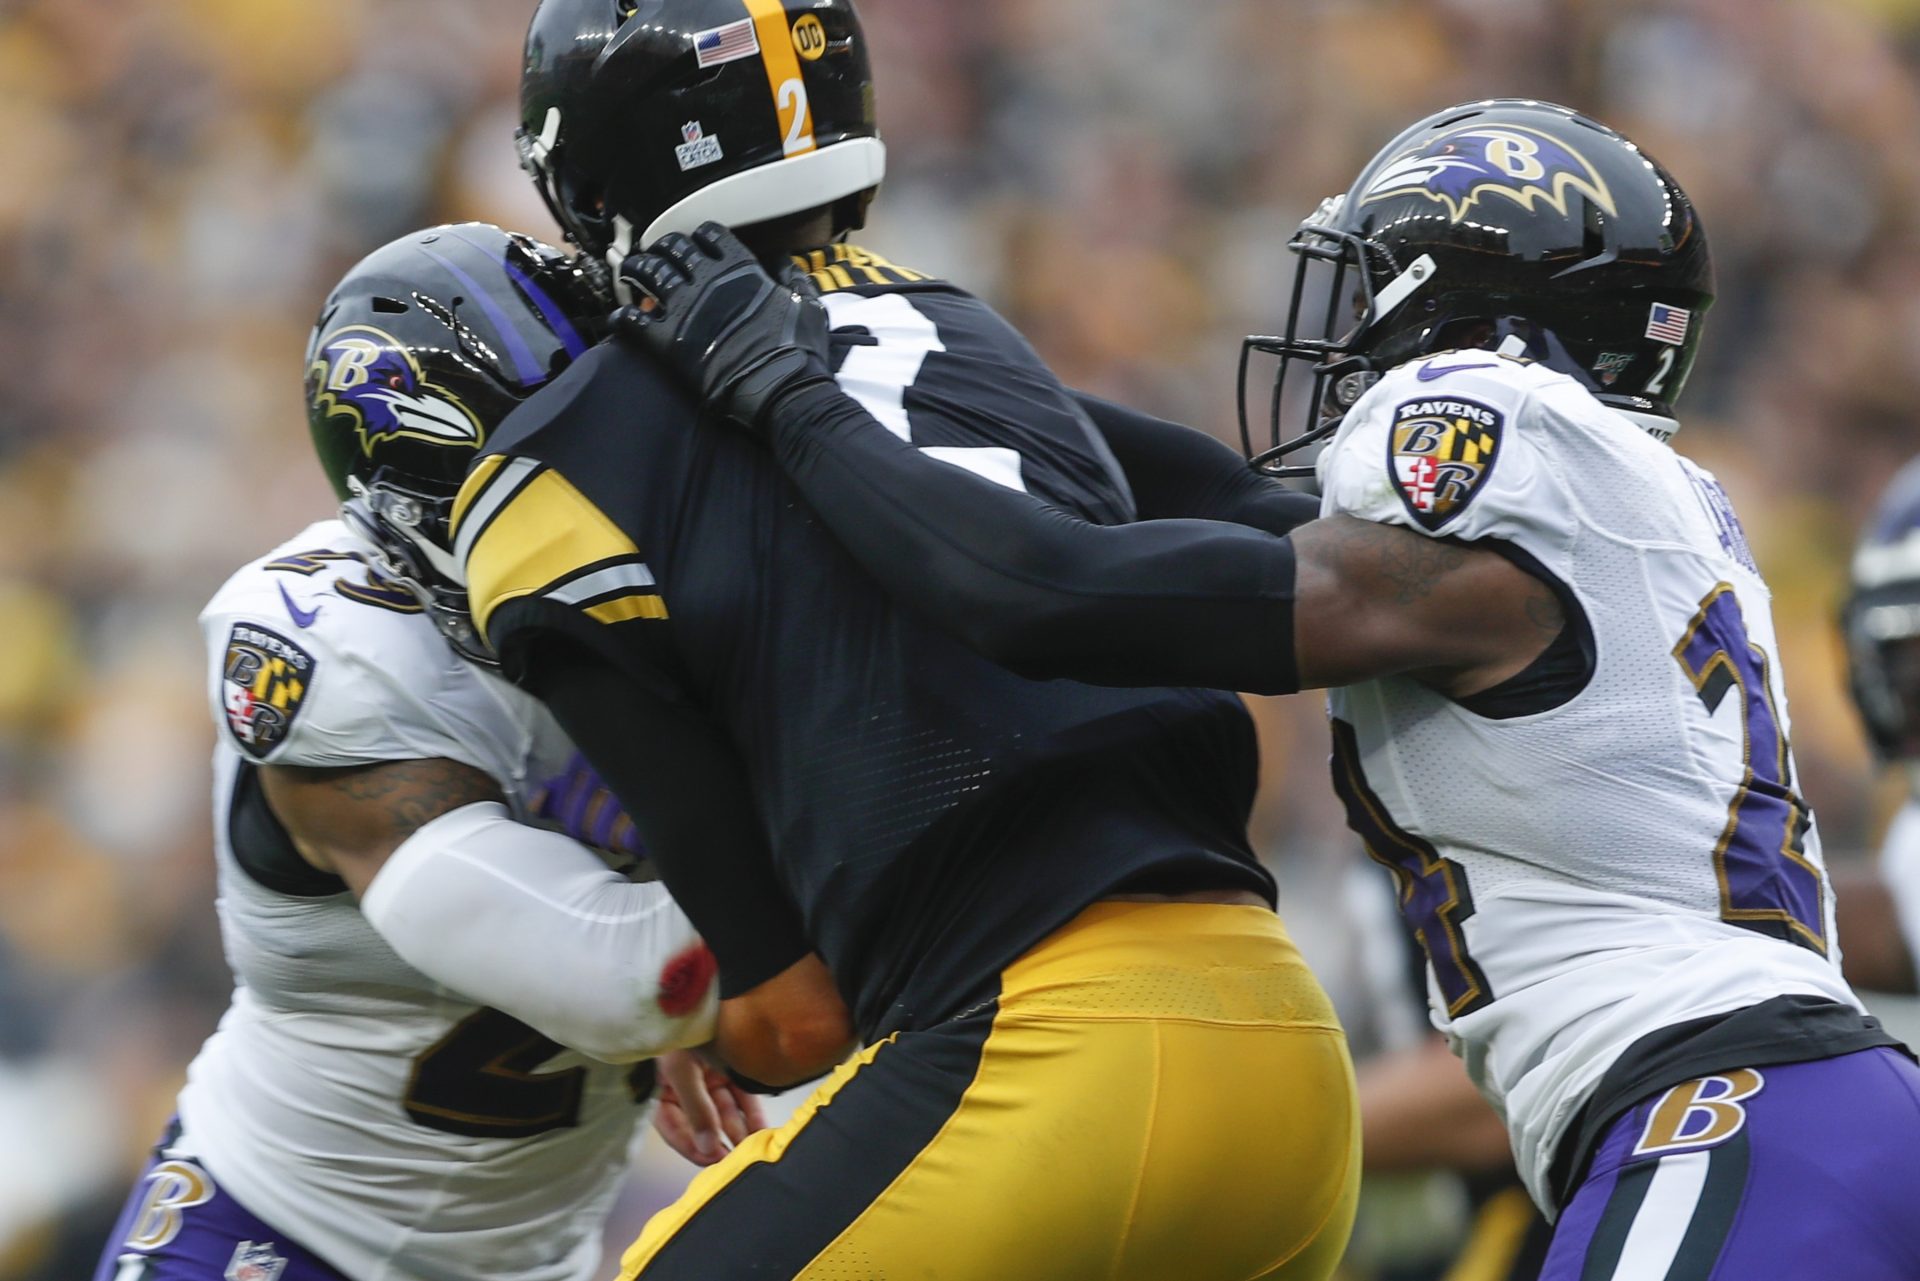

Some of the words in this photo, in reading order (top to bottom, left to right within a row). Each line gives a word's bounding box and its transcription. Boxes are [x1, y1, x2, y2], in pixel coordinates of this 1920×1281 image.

[777, 78, 813, 155] 2
[1485, 131, 1545, 181] B
[326, 338, 381, 391] B
[1645, 347, 1675, 394] 2
[1396, 420, 1449, 454] B
[1399, 401, 1496, 426] RAVENS
[1432, 462, 1481, 501] R
[224, 646, 264, 688] B
[249, 701, 287, 741] R
[1632, 1067, 1765, 1156] B
[125, 1161, 215, 1251] B
